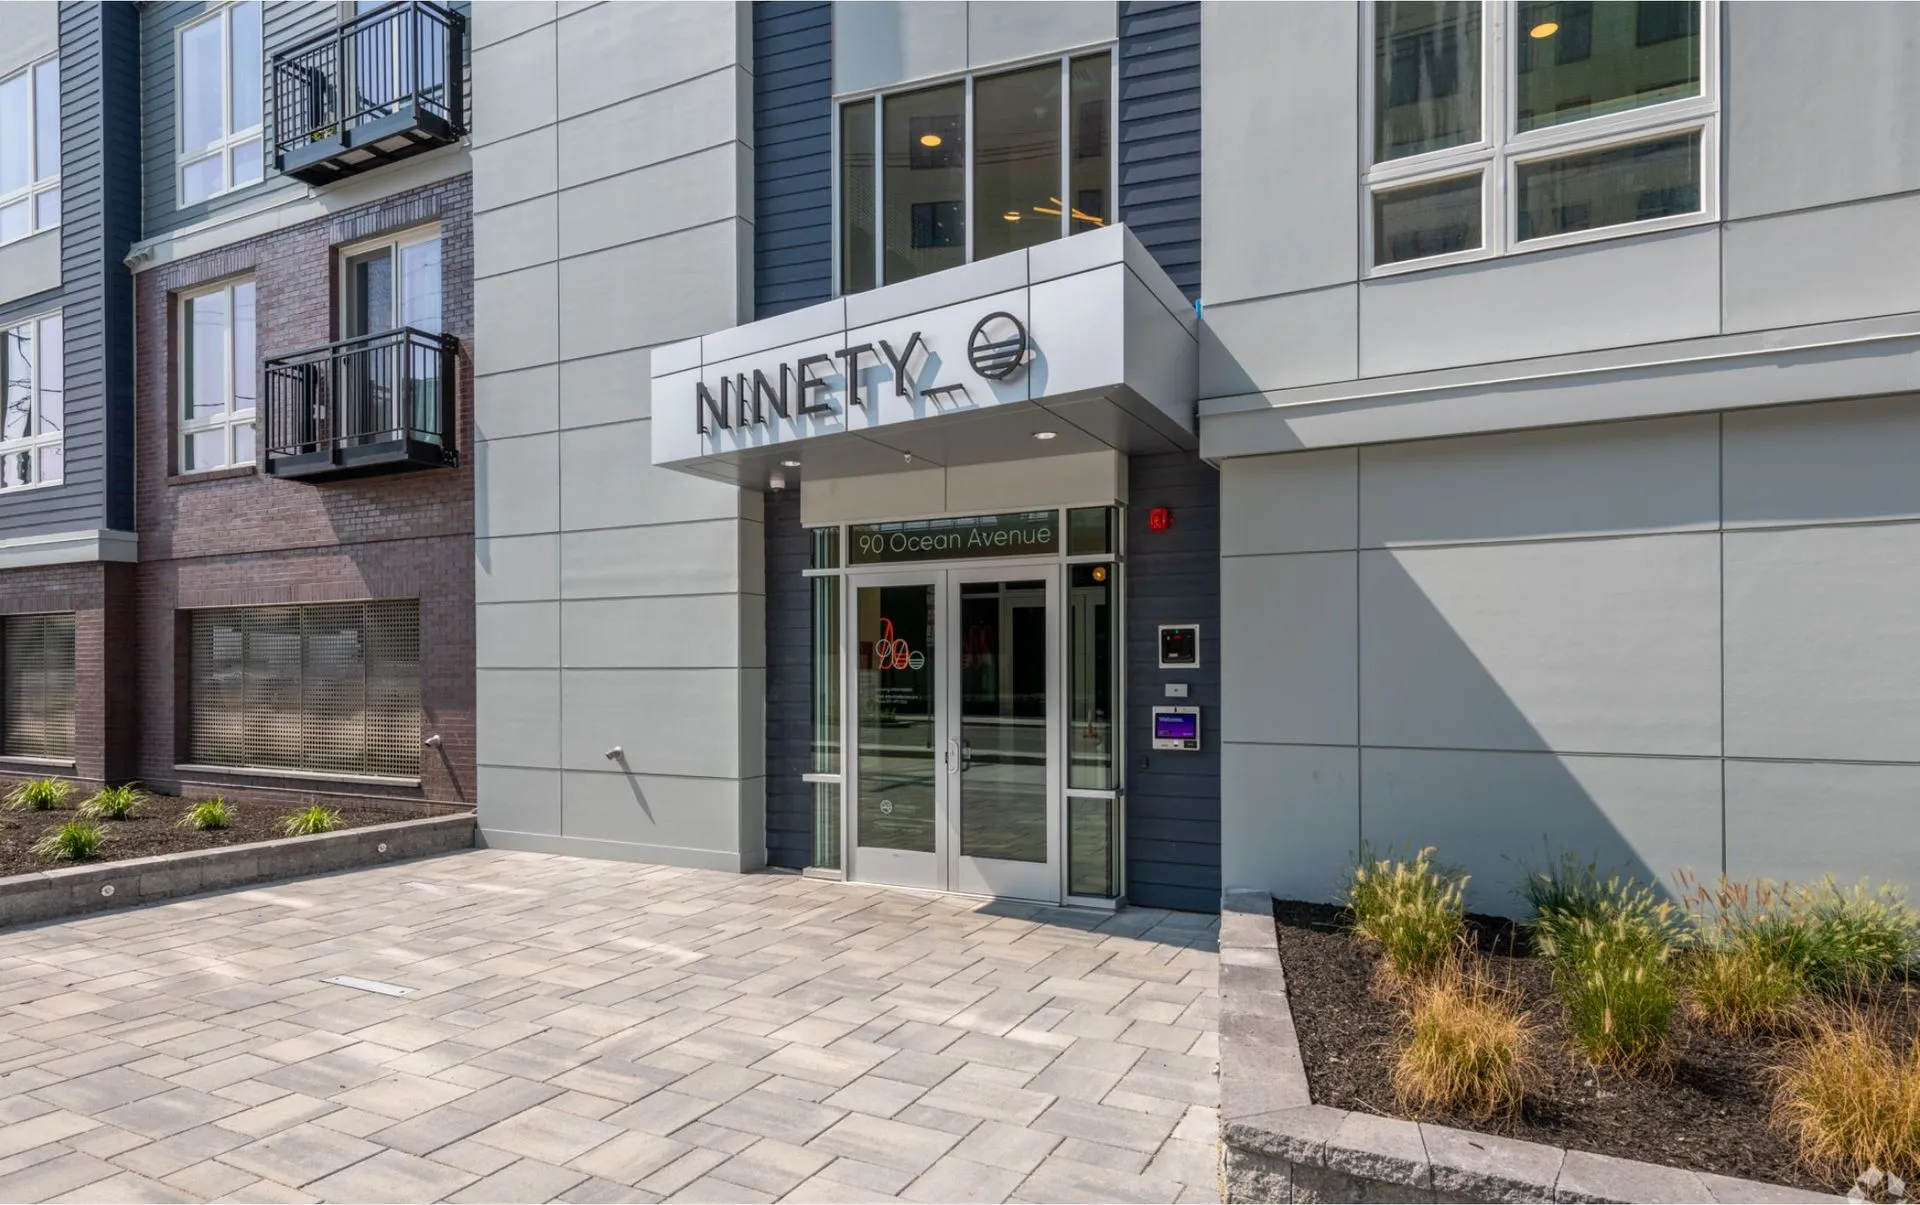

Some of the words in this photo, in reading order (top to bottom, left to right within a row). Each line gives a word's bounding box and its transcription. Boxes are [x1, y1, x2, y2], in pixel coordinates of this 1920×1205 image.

[859, 534, 884, 555] 90
[890, 532, 961, 553] Ocean
[968, 527, 1051, 548] Avenue
